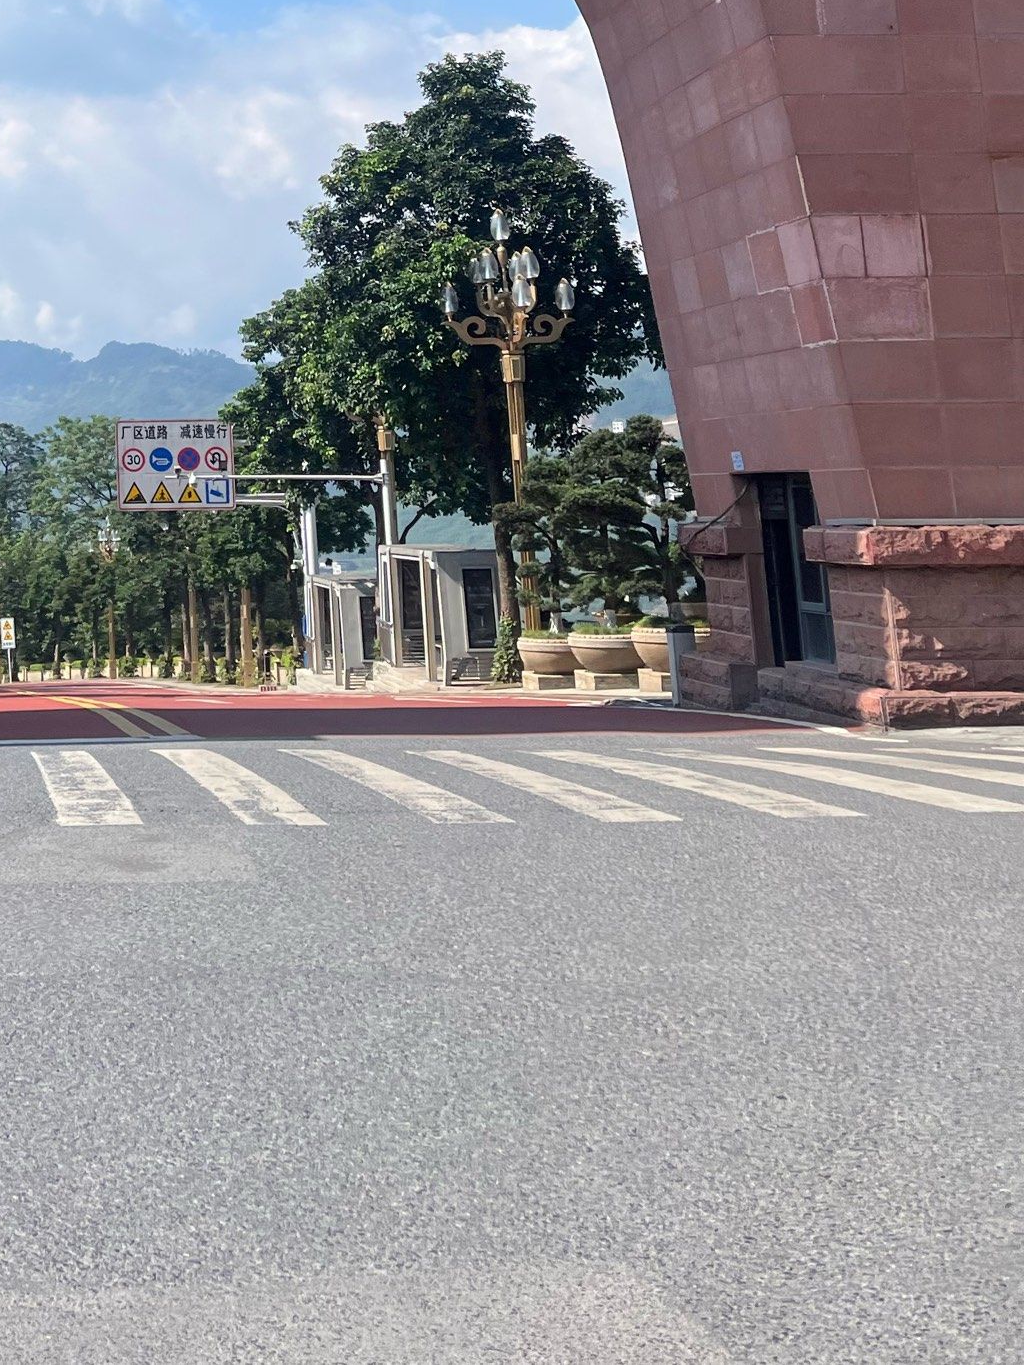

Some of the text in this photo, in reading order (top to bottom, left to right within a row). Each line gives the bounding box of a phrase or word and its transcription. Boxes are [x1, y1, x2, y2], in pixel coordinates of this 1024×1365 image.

[121, 424, 228, 440] 厂区道路 减速慢行
[126, 454, 141, 466] 30
